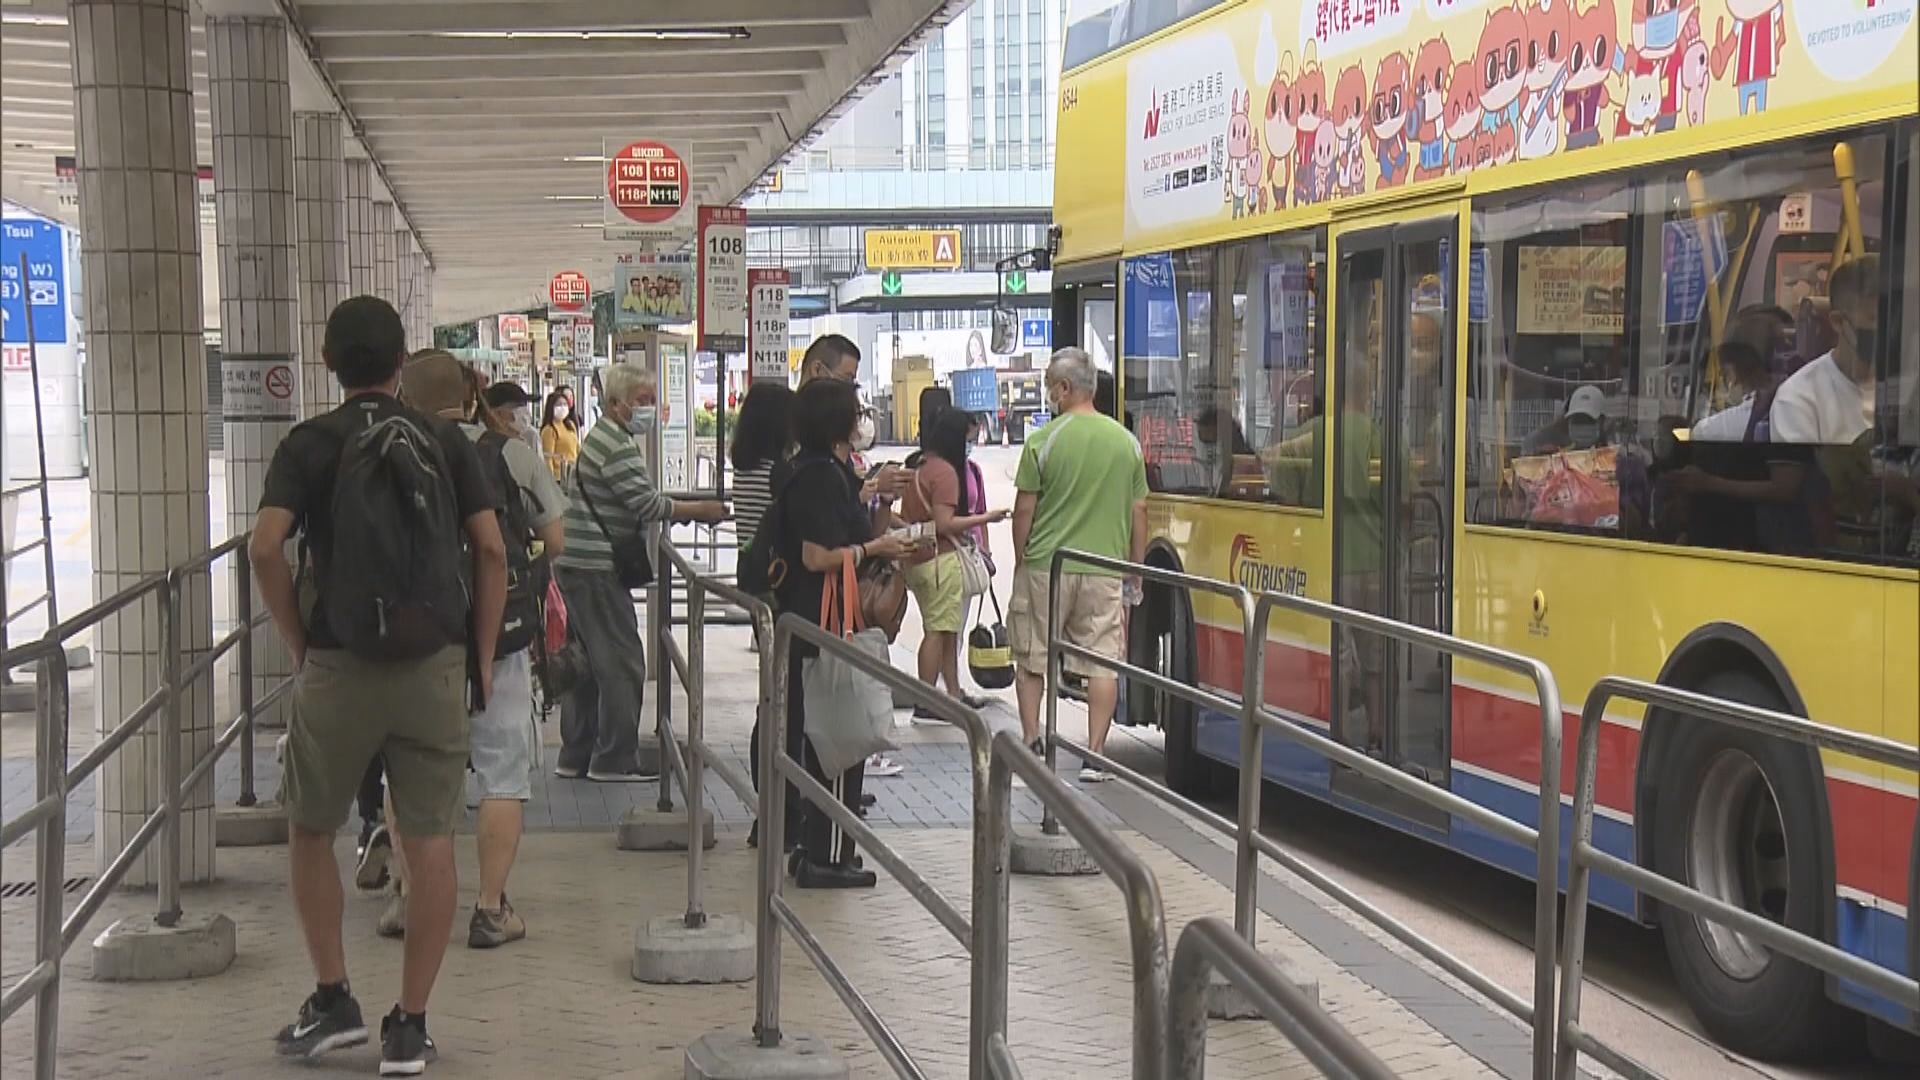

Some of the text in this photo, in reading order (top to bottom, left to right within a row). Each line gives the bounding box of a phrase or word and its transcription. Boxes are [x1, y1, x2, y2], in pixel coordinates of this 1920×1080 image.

[1807, 8, 1911, 47] DEVOTED TO VOLUNTEERING
[621, 164, 675, 177] 108 118
[620, 188, 679, 201] 118P N118
[5, 224, 34, 238] Tsui
[708, 236, 742, 255] 108
[879, 235, 921, 245] Autotoll
[757, 288, 784, 302] 118
[755, 320, 786, 332] 118P
[755, 350, 787, 363] N118
[1239, 560, 1284, 593] CITYBUS
